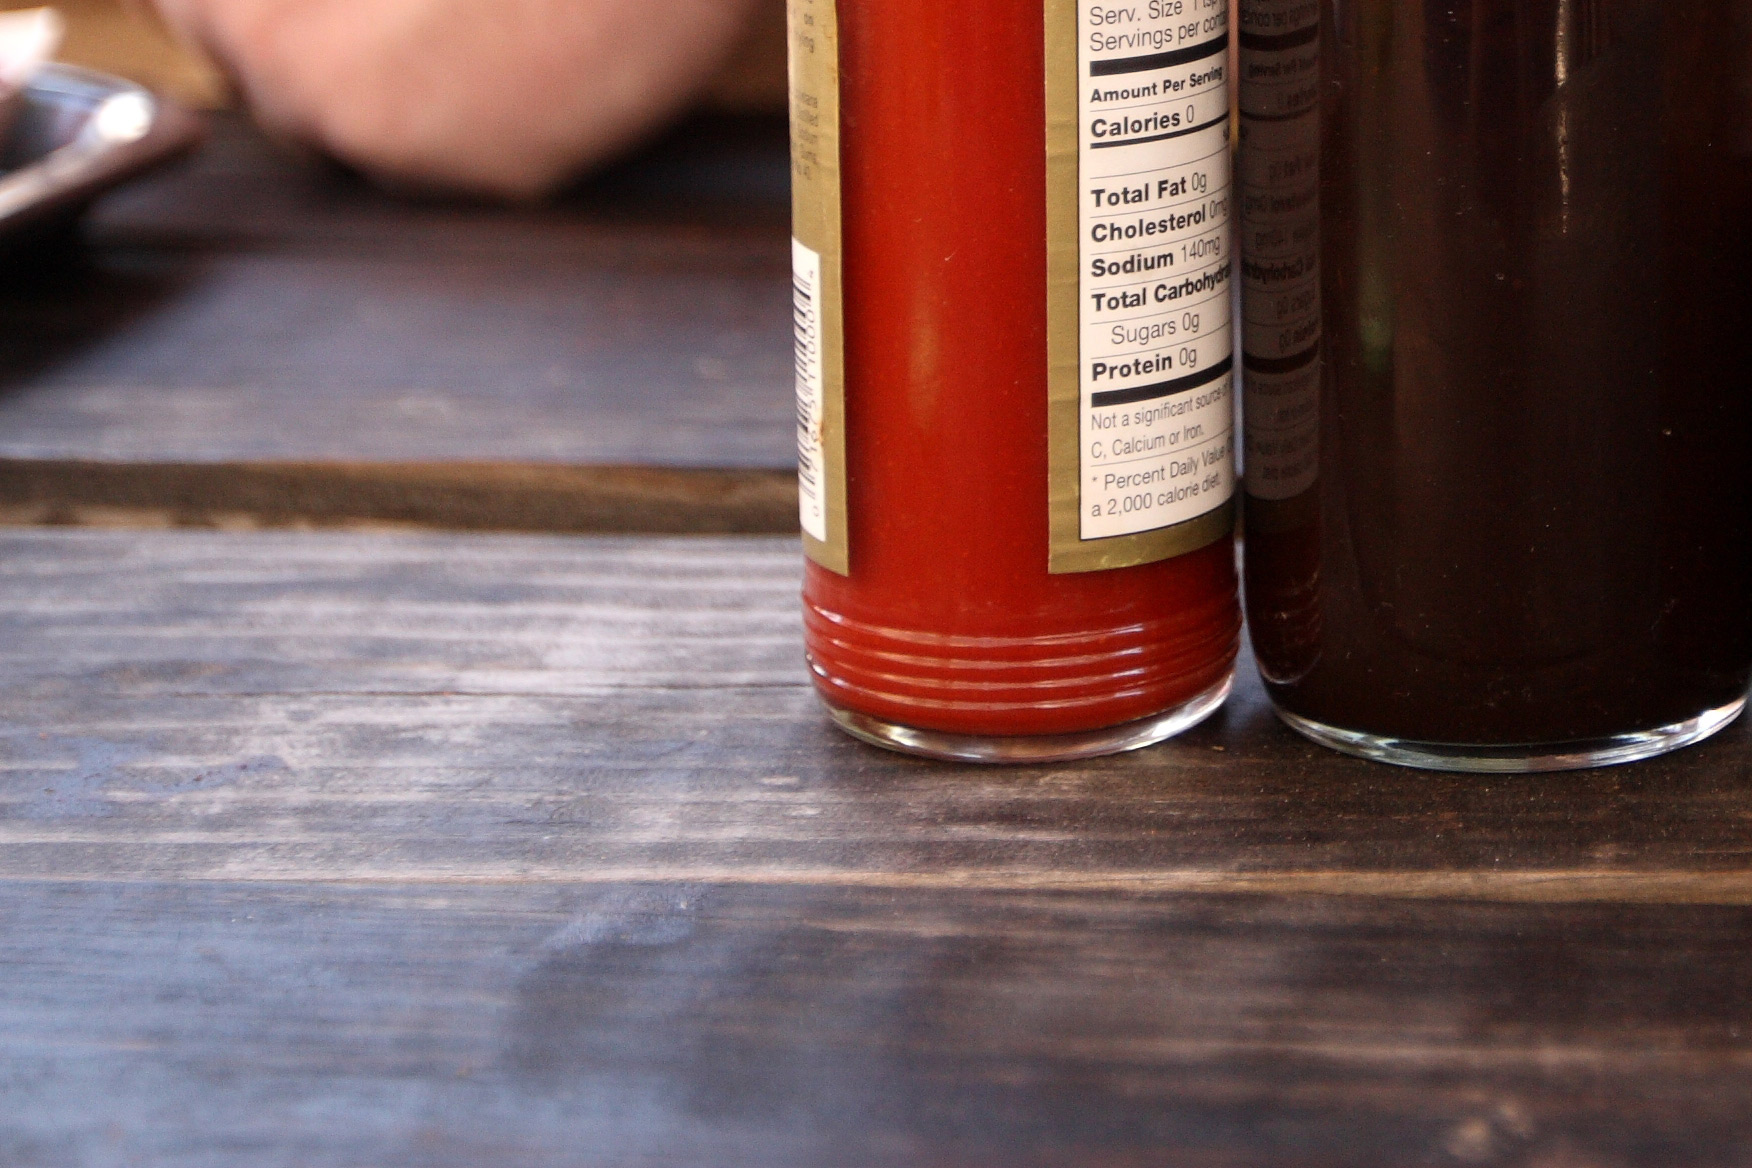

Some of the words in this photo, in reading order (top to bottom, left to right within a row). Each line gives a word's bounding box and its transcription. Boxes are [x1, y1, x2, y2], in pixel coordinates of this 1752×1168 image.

[1090, 4, 1141, 26] Serv.
[1090, 25, 1173, 52] Servings
[1177, 20, 1200, 44] per
[1090, 82, 1158, 103] Amount
[1163, 78, 1185, 94] Per
[1189, 65, 1223, 89] Serving
[1090, 109, 1181, 137] Calories
[1186, 104, 1195, 123] 0
[1090, 182, 1149, 208] Total
[1157, 176, 1187, 200] Fat
[1191, 171, 1207, 194] 0g
[1091, 203, 1206, 243] Cholesterol
[1091, 248, 1174, 277] Sodium
[1181, 234, 1221, 264] 140mg
[1091, 286, 1147, 312] Total
[1111, 317, 1177, 347] Sugars
[1181, 311, 1200, 335] 0g
[1091, 351, 1173, 382] Protein
[1178, 346, 1198, 370] 0g
[1091, 412, 1117, 431] Not
[1121, 413, 1131, 427] a
[1133, 395, 1194, 427] significant
[1112, 431, 1165, 457] Calcium
[1168, 429, 1181, 445] or
[1104, 465, 1166, 491] Percent
[1169, 453, 1200, 480] Daily
[1201, 447, 1226, 470] Value
[1091, 502, 1102, 518] a
[1106, 490, 1153, 518] 2,000
[1156, 481, 1199, 508] calorie
